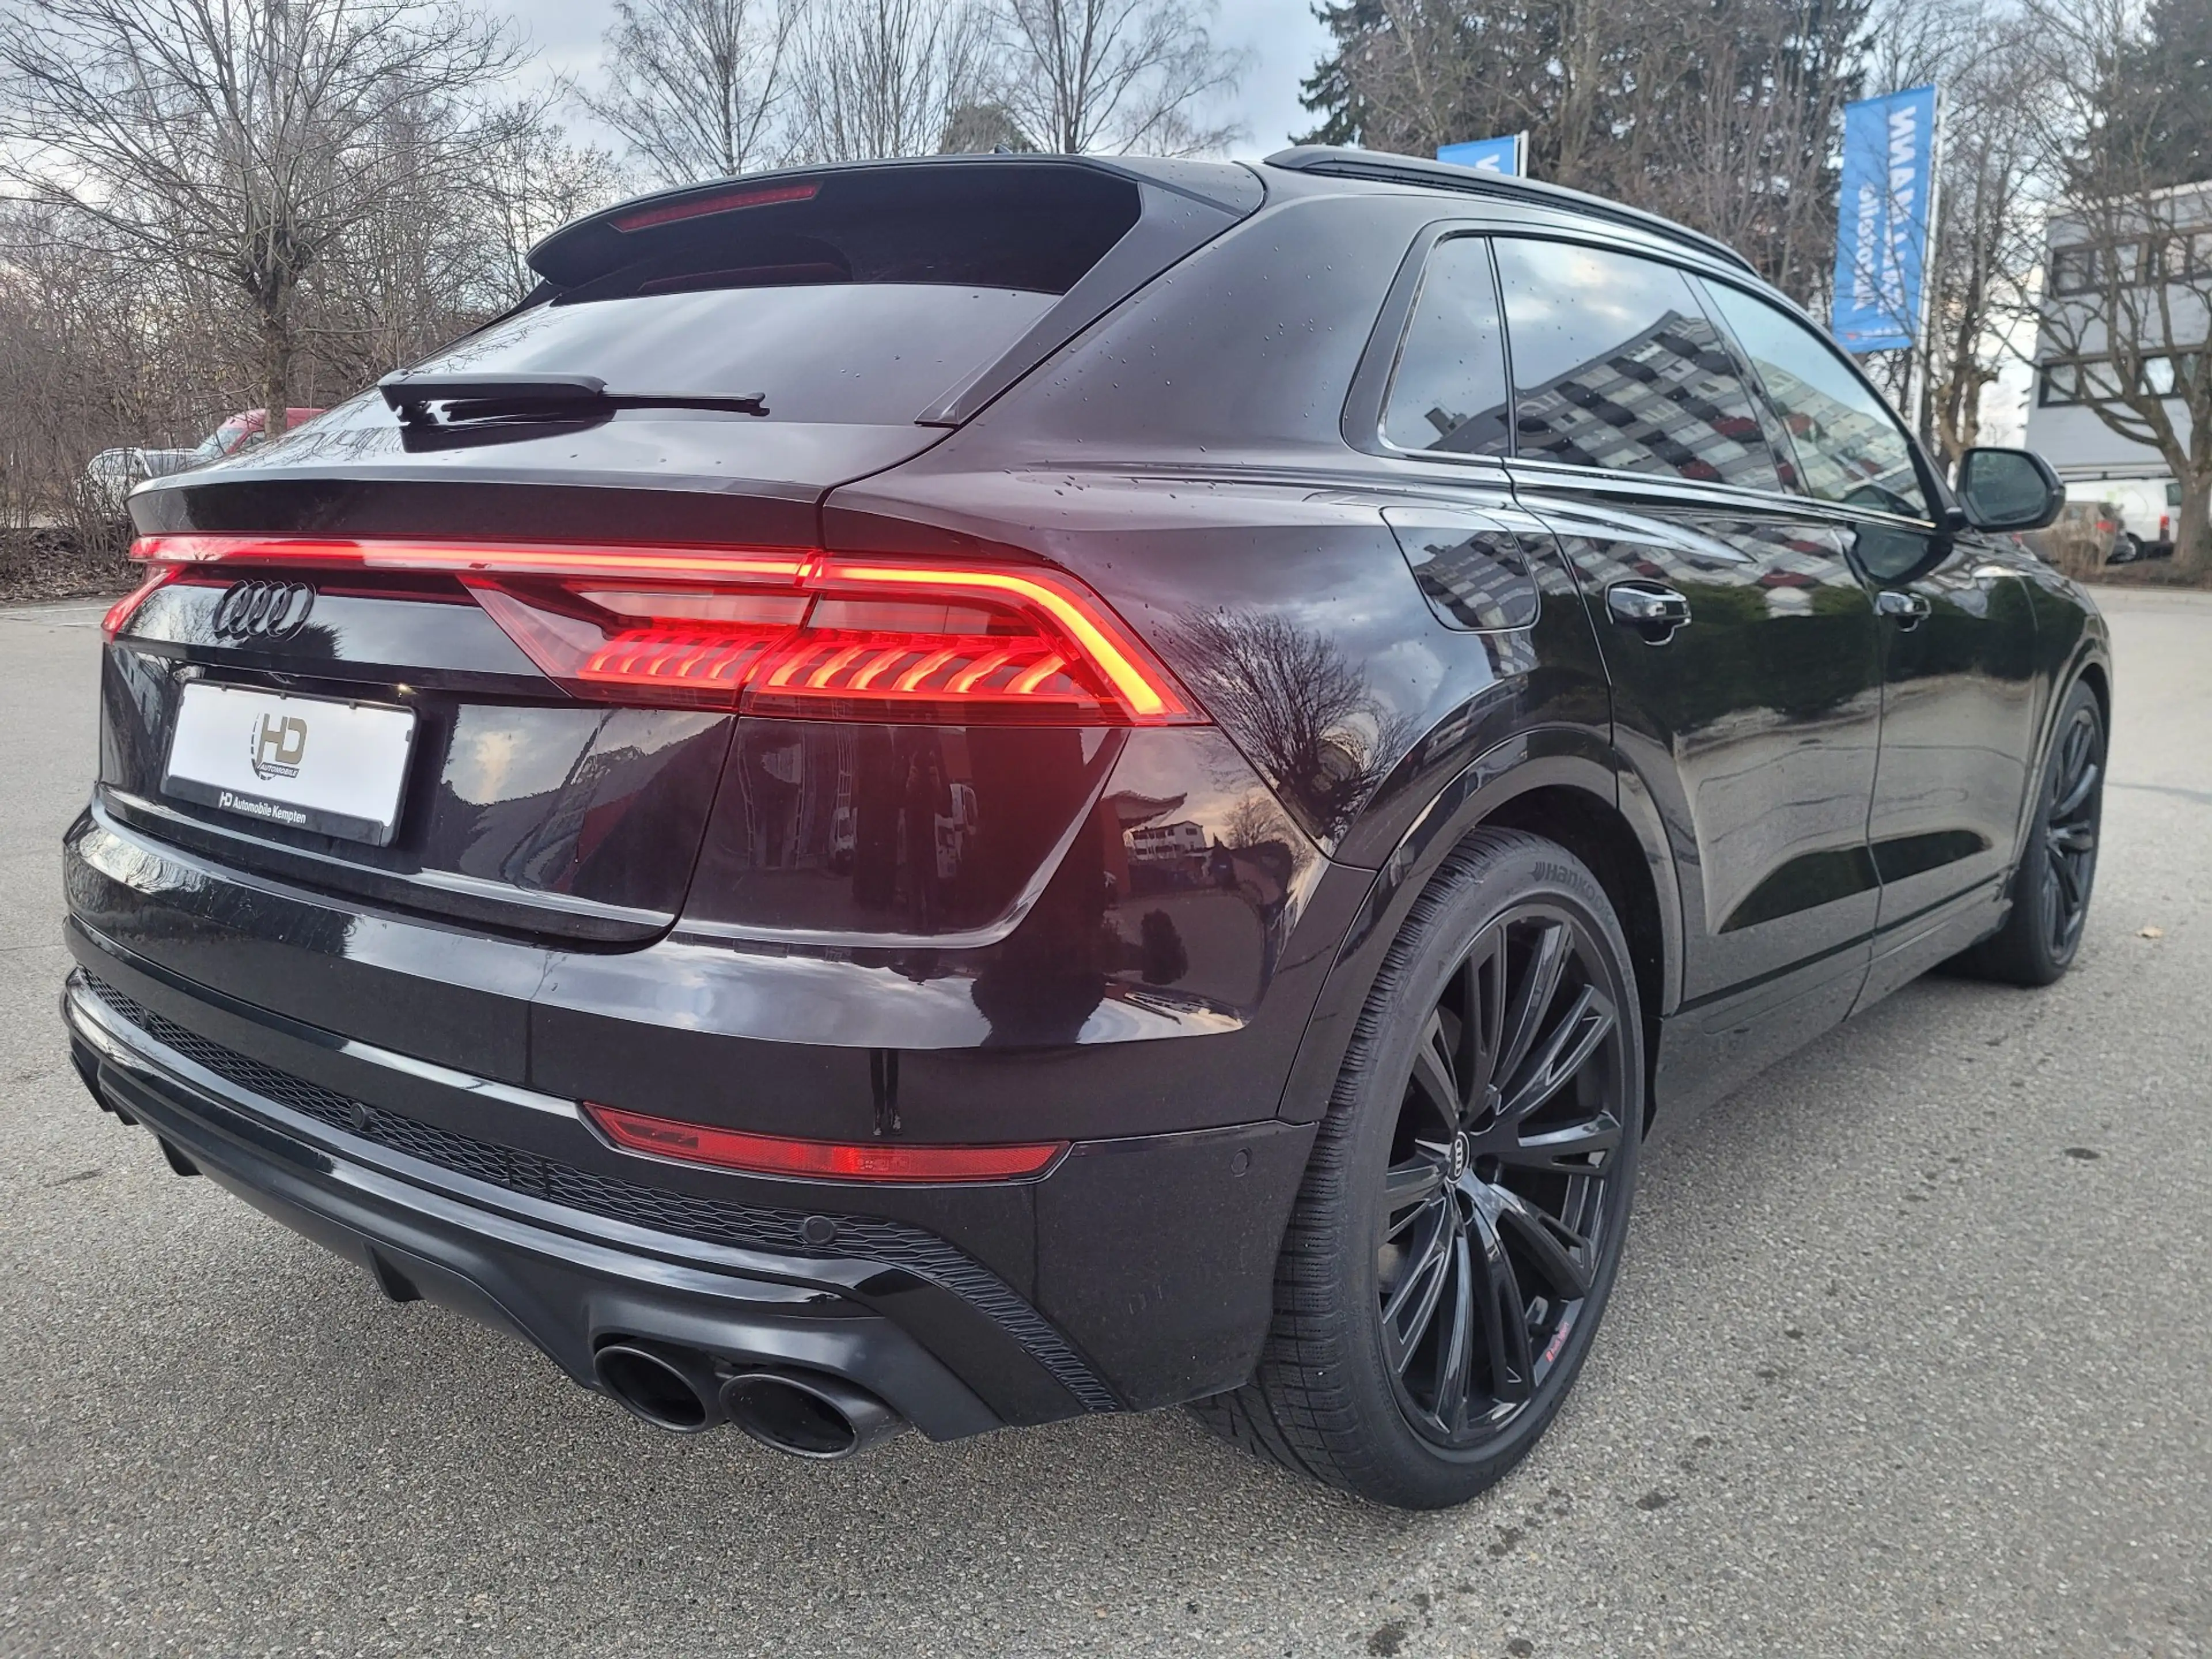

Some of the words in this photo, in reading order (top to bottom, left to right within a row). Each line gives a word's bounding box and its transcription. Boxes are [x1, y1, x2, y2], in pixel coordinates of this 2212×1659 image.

[256, 713, 307, 768] HD
[259, 764, 298, 777] AUTOMOBILE
[219, 791, 233, 808] HD
[232, 796, 272, 817] Automobile
[271, 805, 307, 824] Kempten
